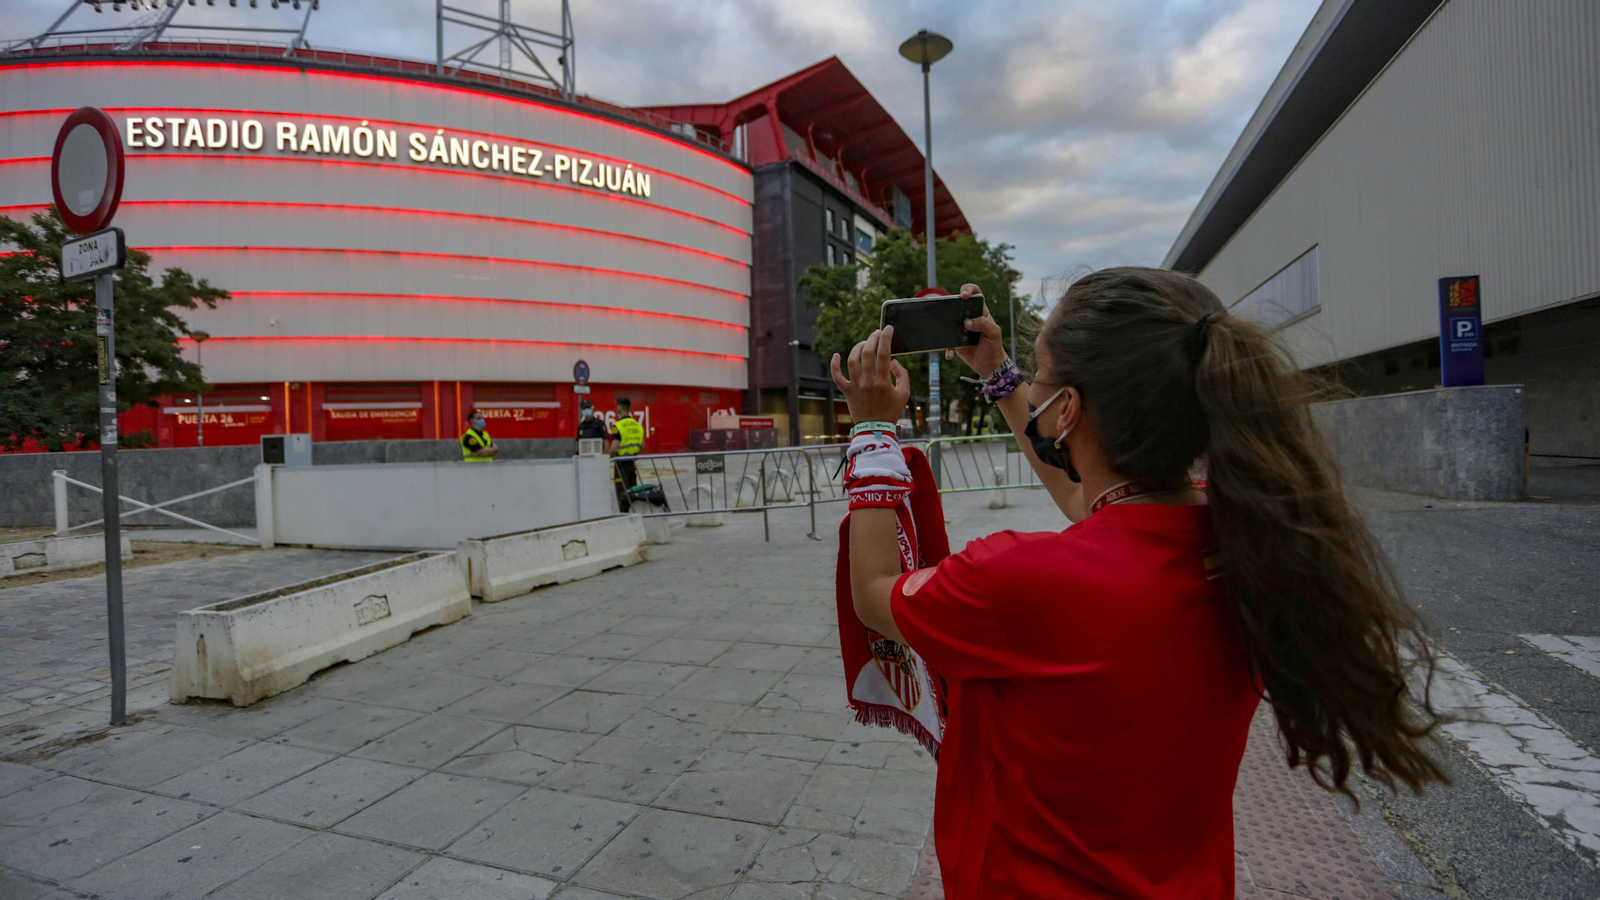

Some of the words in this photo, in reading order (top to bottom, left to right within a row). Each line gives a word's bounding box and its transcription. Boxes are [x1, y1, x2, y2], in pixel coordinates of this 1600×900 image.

[126, 117, 263, 150] ESTADIO
[276, 120, 397, 158] RAMÓN
[408, 129, 650, 197] SÁNCHEZ-PIZJUÁN
[79, 240, 98, 254] ZONA
[1457, 321, 1472, 337] P
[220, 414, 233, 424] 26
[331, 411, 357, 419] SALIDA
[370, 410, 417, 418] EMERGENCIA
[481, 409, 511, 418] UERTA
[513, 409, 524, 418] 27
[1106, 487, 1127, 503] ADEXE
